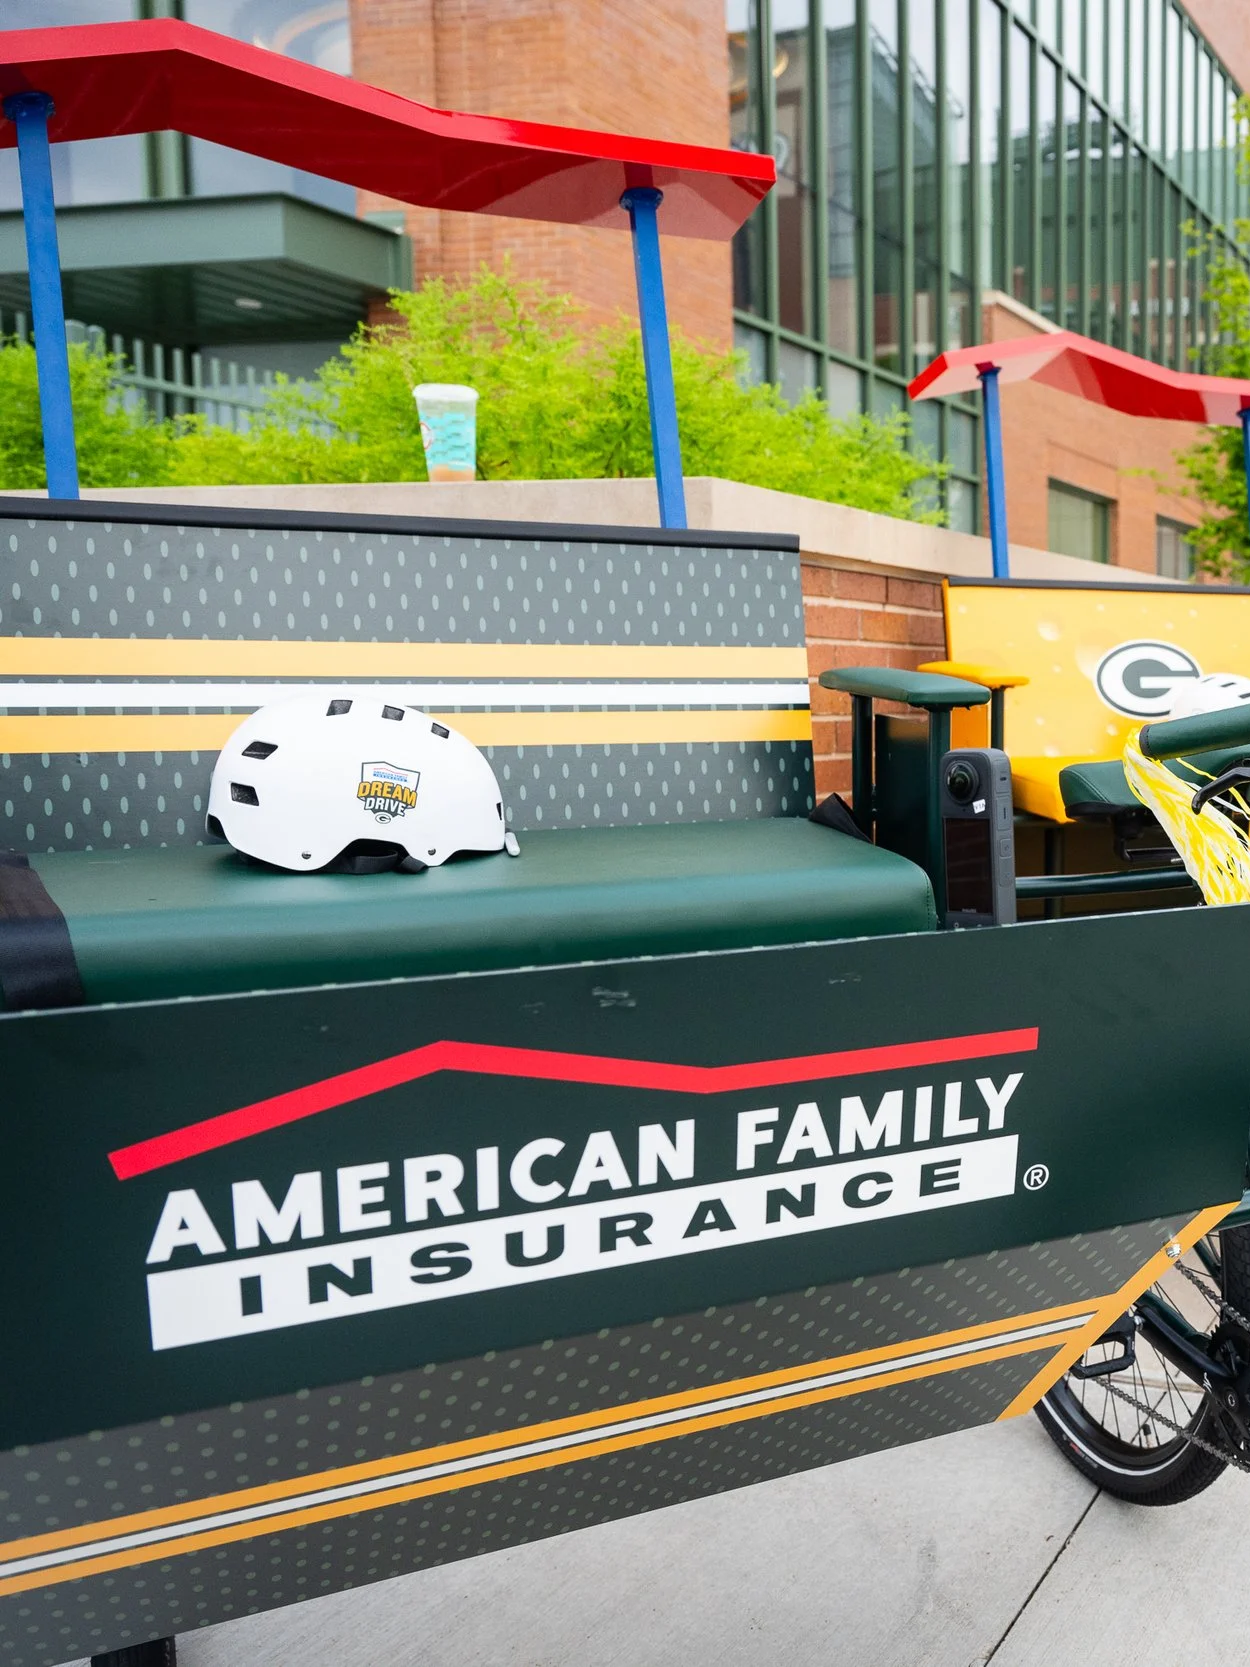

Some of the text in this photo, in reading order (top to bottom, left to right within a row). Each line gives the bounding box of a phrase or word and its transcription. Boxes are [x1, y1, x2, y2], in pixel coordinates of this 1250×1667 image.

[358, 781, 417, 807] DREAM
[364, 797, 407, 816] DRIVE
[147, 1073, 1023, 1263] AMERICAN FAMILY
[240, 1157, 963, 1317] INSURANCE
